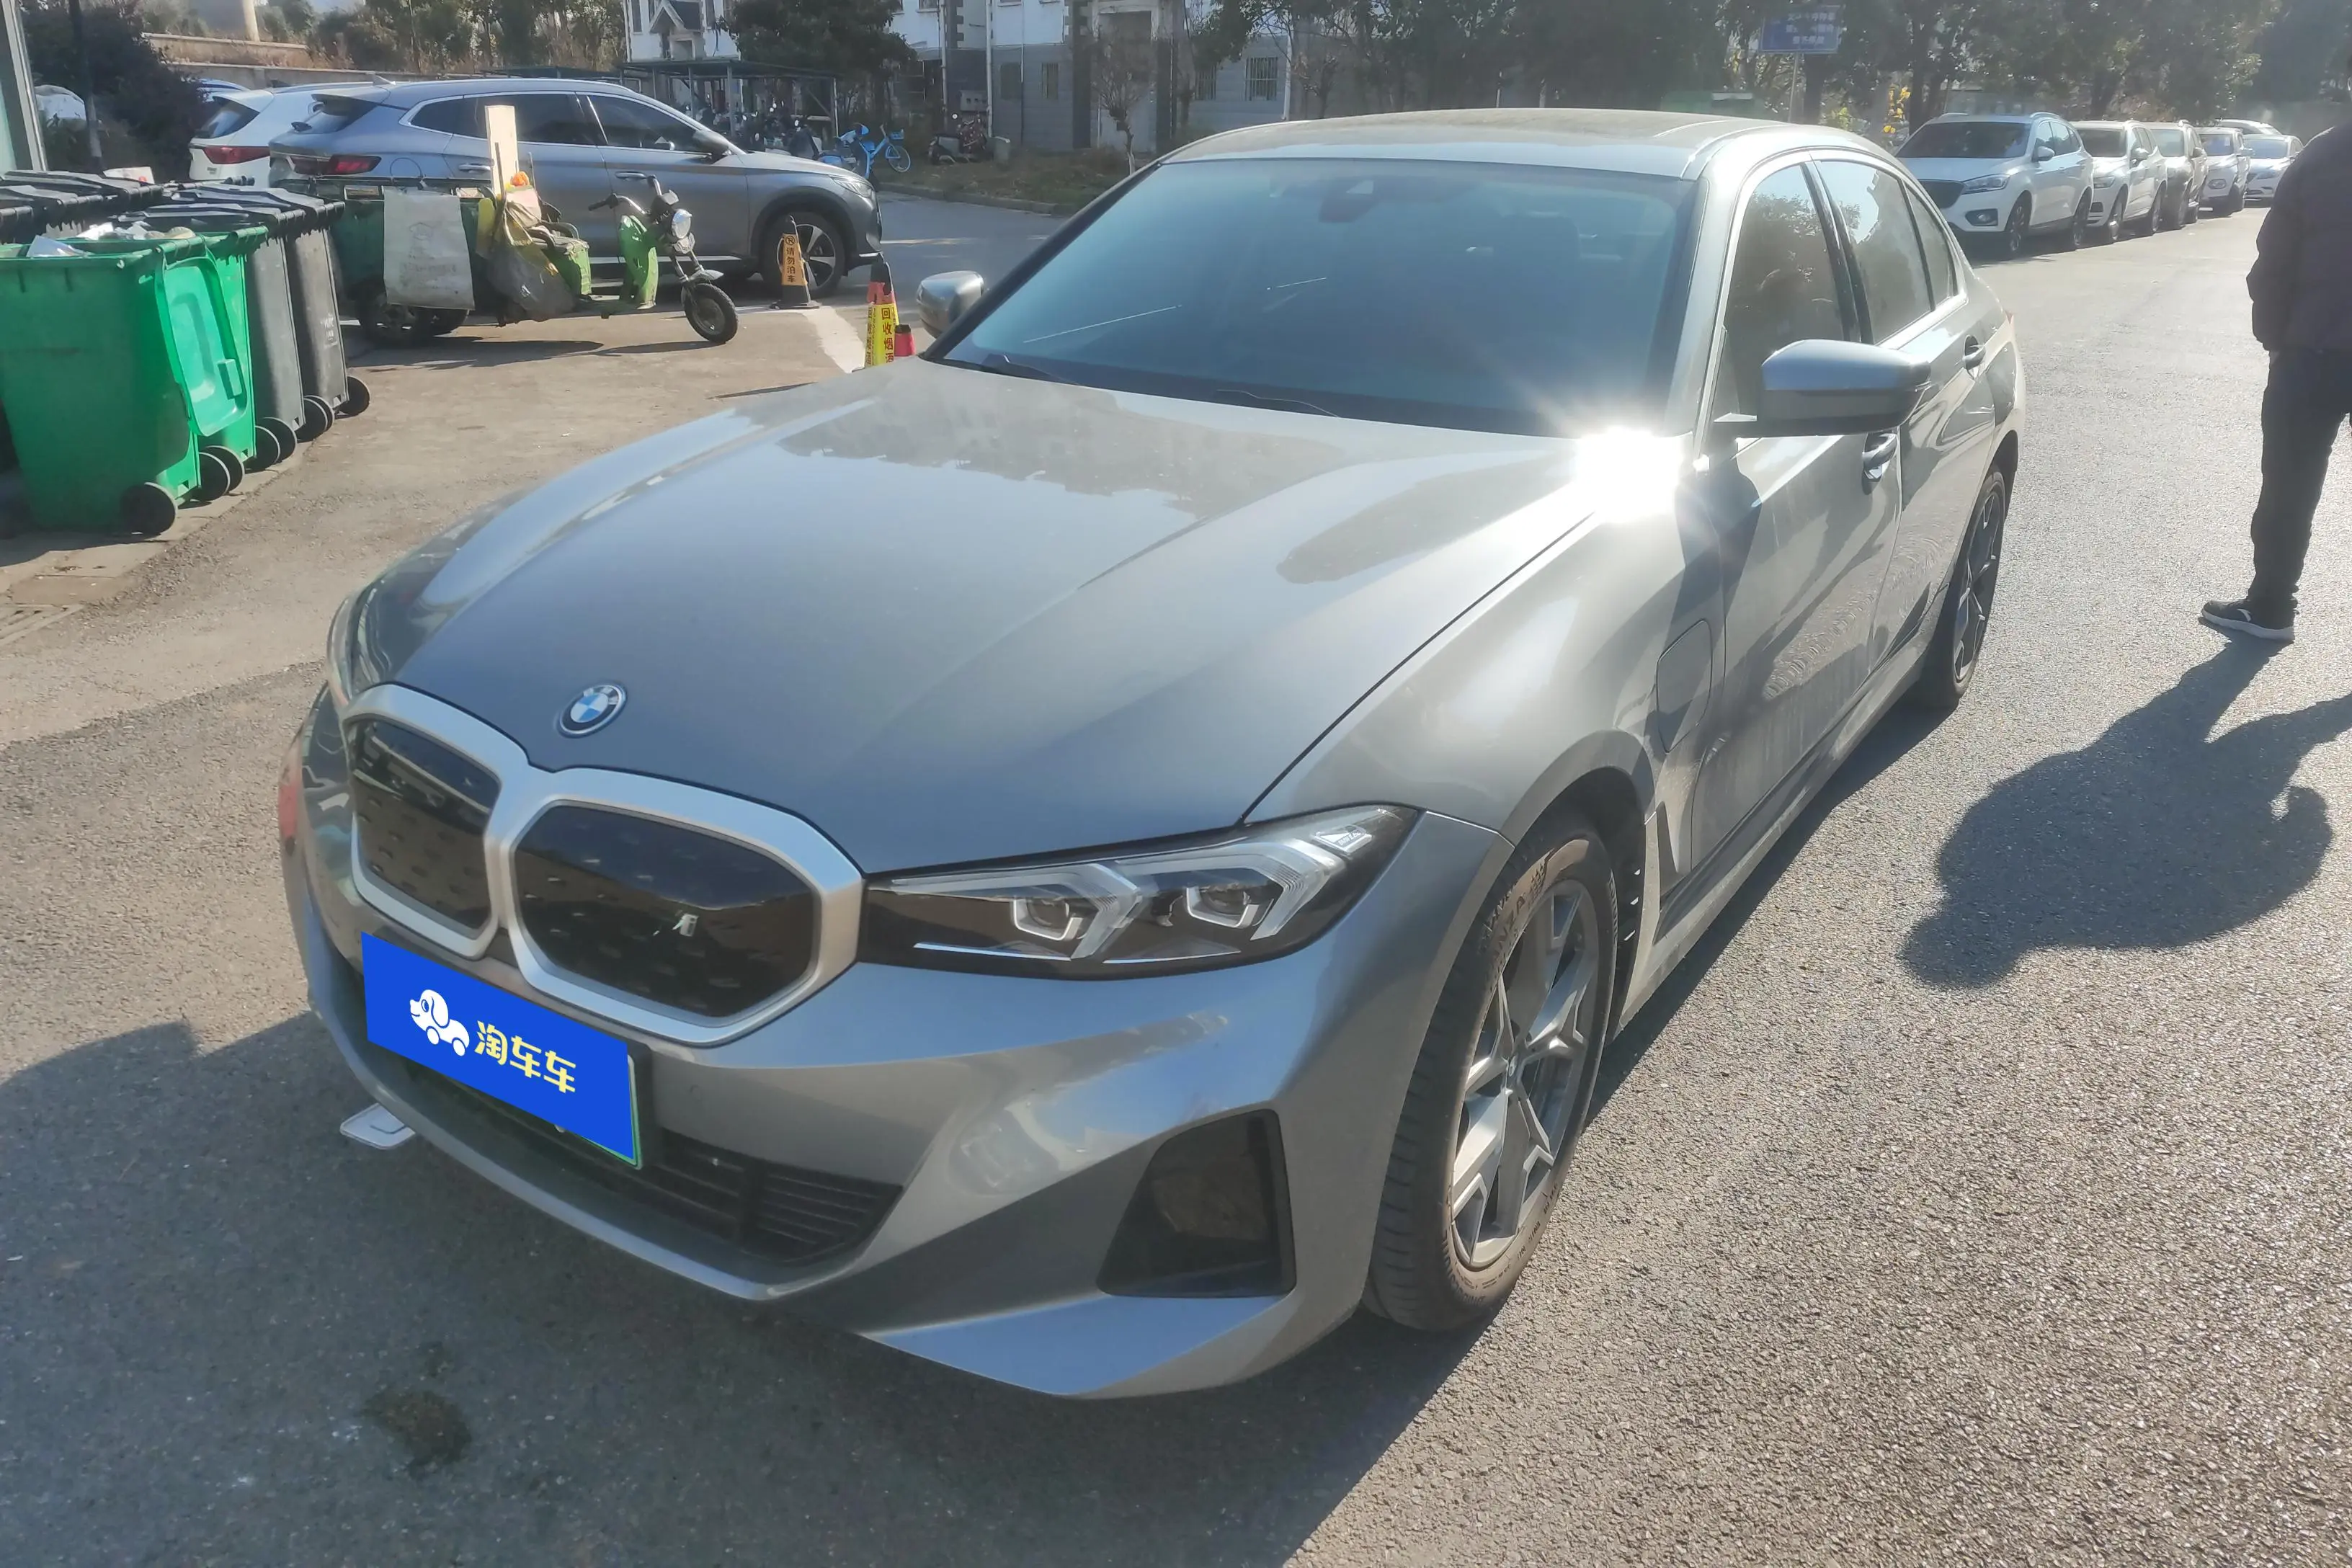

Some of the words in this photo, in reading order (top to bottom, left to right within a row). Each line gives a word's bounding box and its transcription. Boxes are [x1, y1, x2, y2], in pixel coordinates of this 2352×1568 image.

[786, 247, 796, 282] 请勿泊车
[881, 307, 894, 363] 回收烟酒
